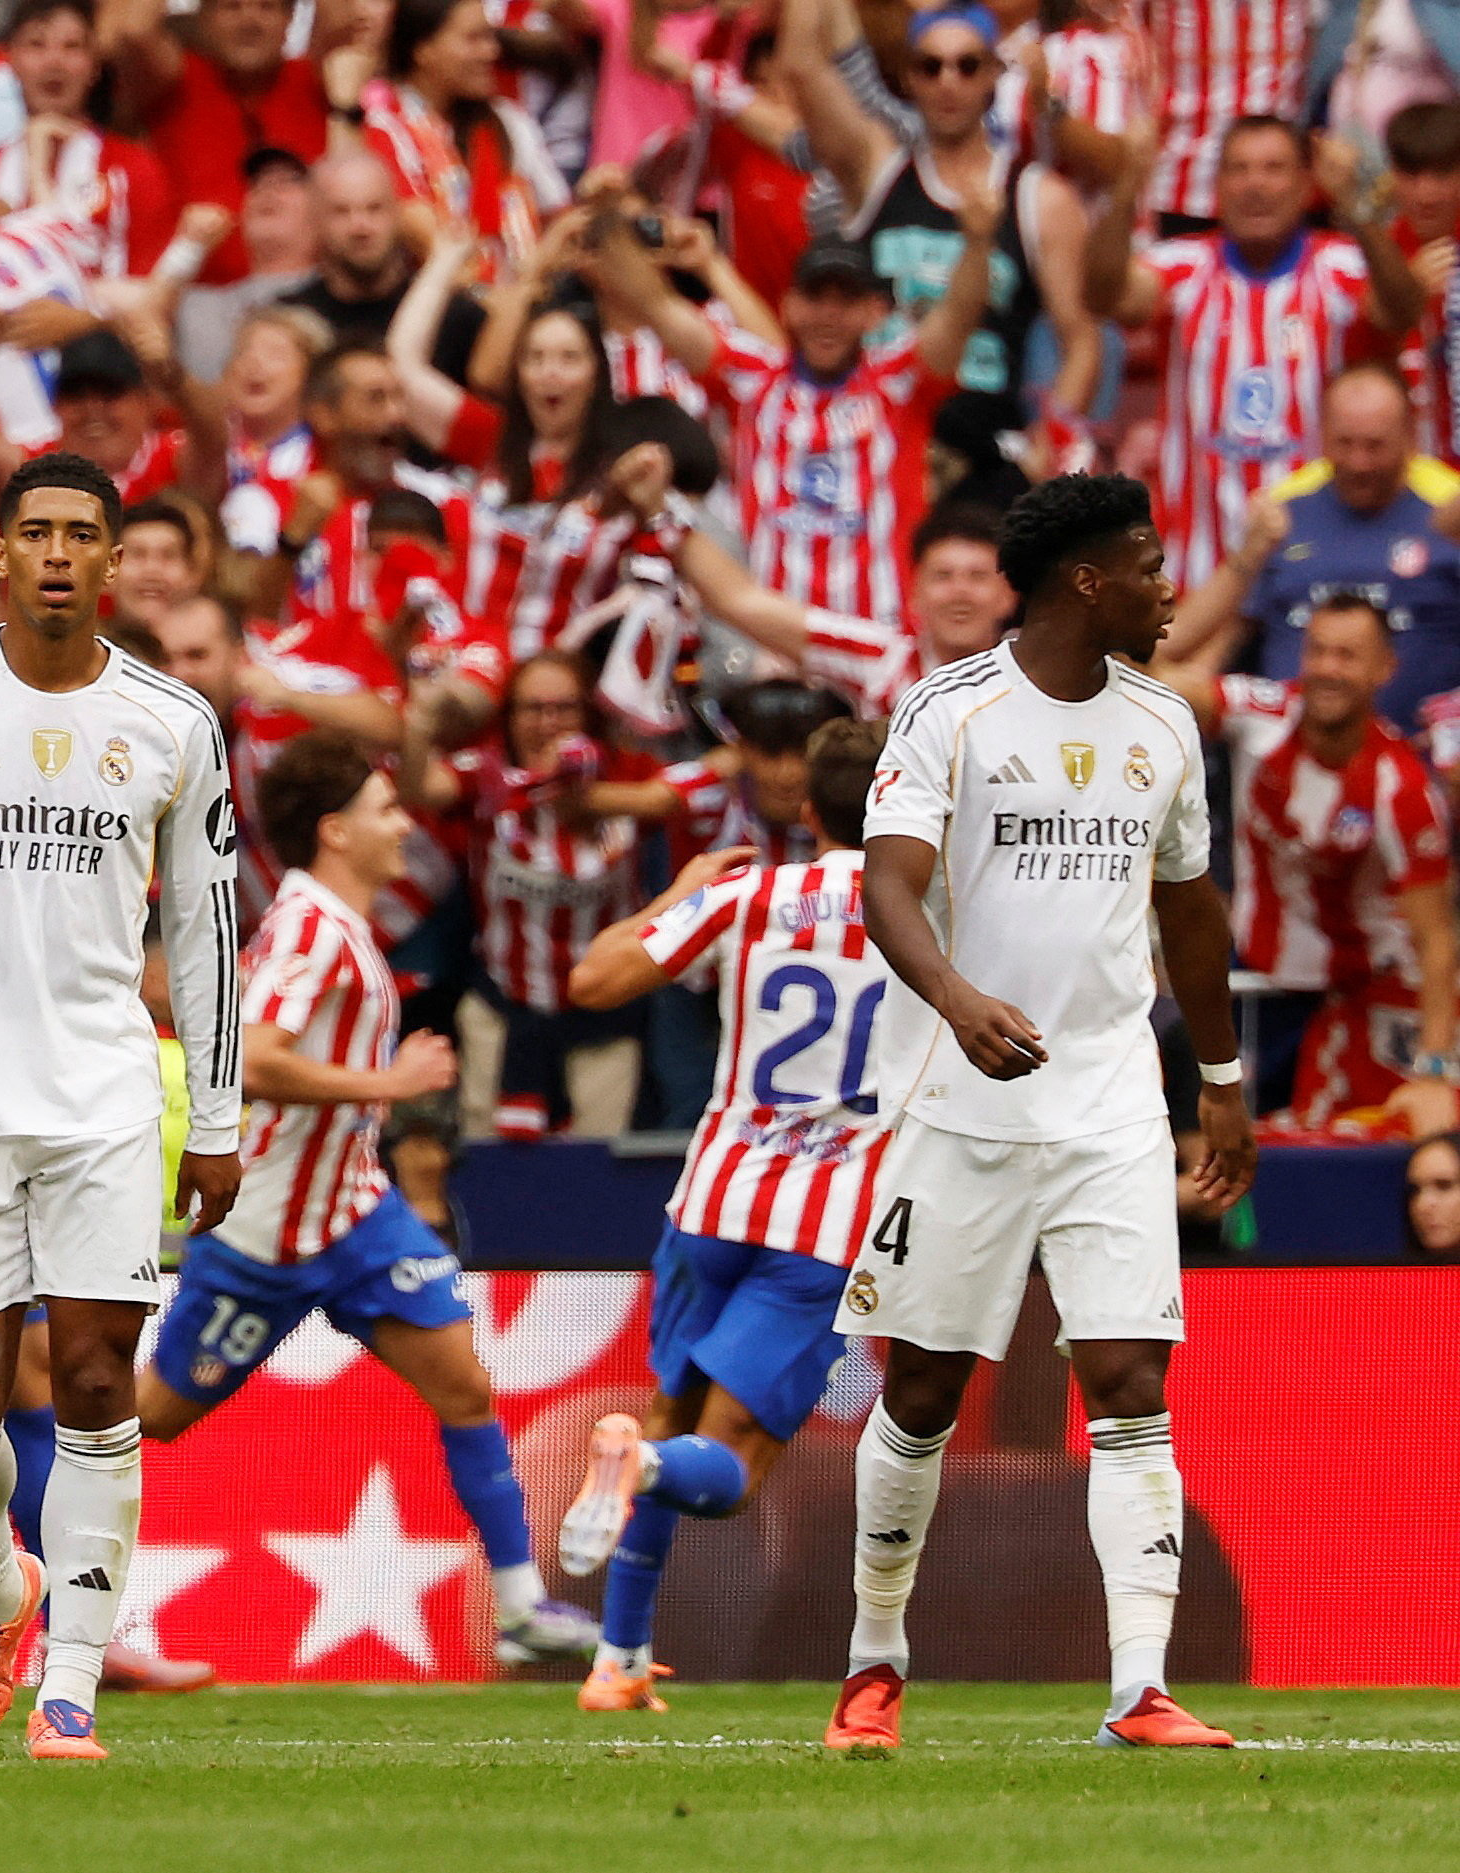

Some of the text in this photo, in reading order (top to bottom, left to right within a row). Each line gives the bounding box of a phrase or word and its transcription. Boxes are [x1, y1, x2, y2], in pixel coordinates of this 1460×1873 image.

[993, 809, 1151, 848] Emirates
[27, 842, 103, 875] BETTER
[1014, 852, 1132, 883] FLY BETTER
[873, 1196, 913, 1266] 4
[198, 1295, 270, 1366] 19
